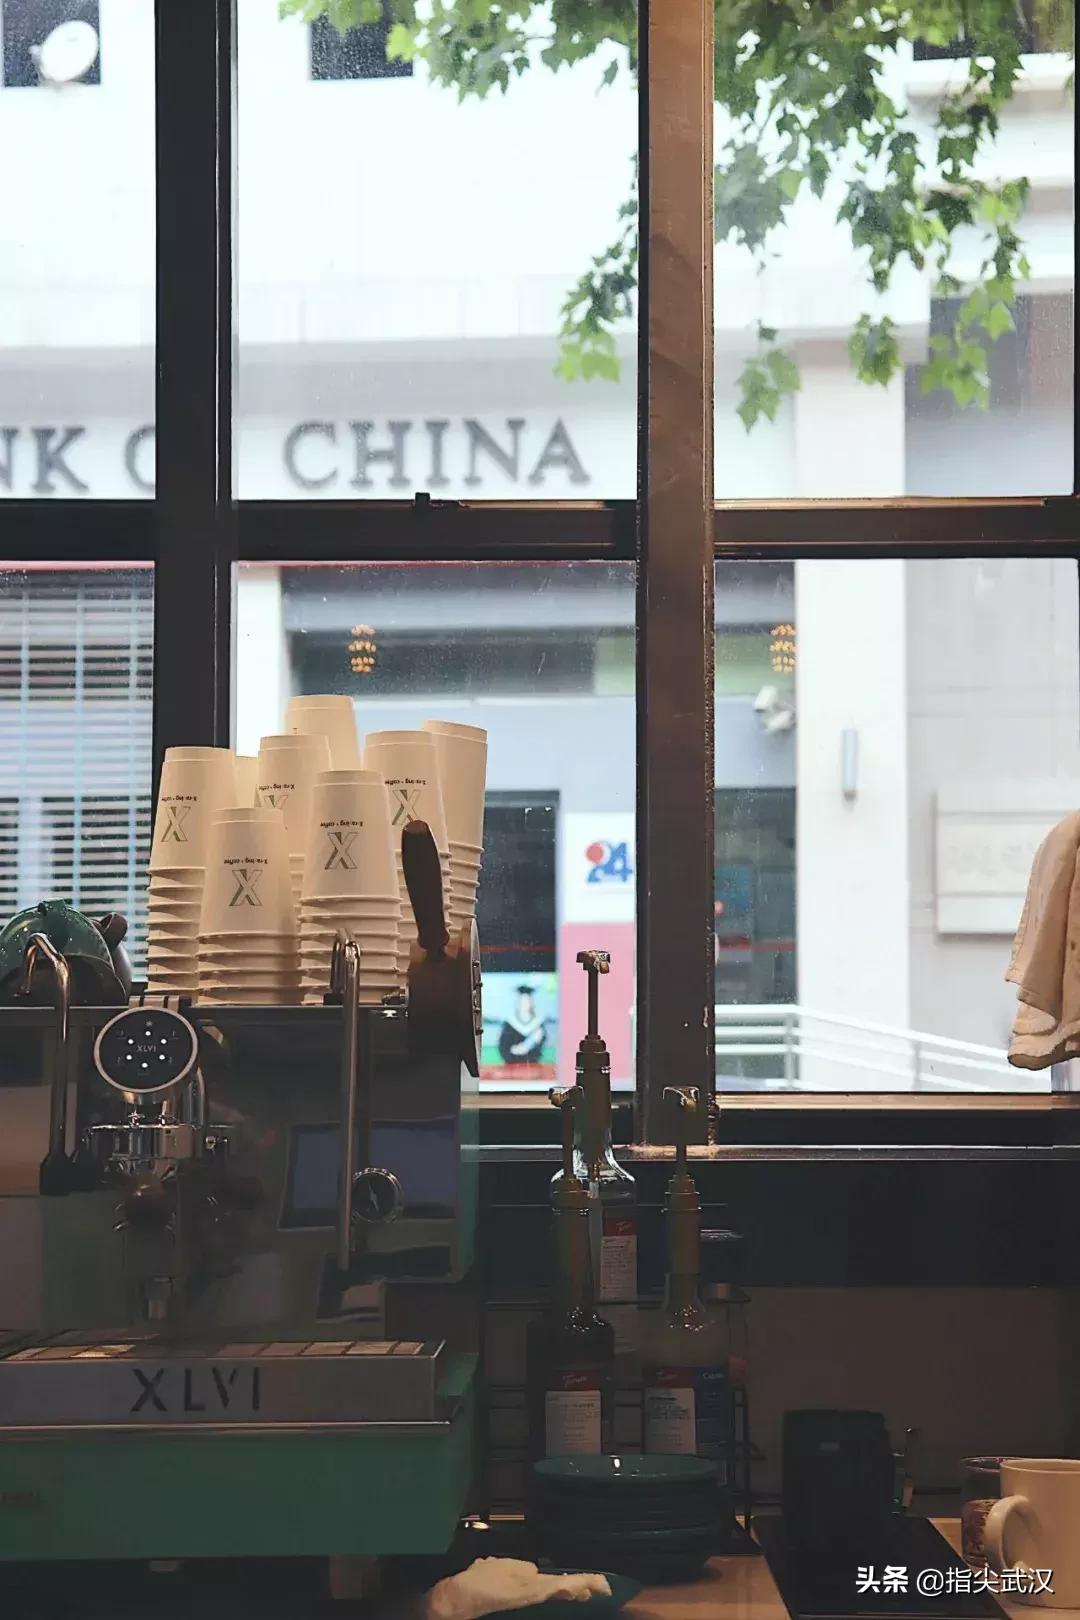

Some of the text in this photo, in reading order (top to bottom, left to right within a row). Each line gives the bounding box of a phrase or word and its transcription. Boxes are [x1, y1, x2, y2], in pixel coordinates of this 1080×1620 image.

[283, 418, 591, 490] CHINA
[161, 806, 191, 842] X
[392, 789, 422, 826] X
[325, 832, 360, 870] X
[229, 869, 263, 906] X
[130, 1367, 260, 1412] XLVI
